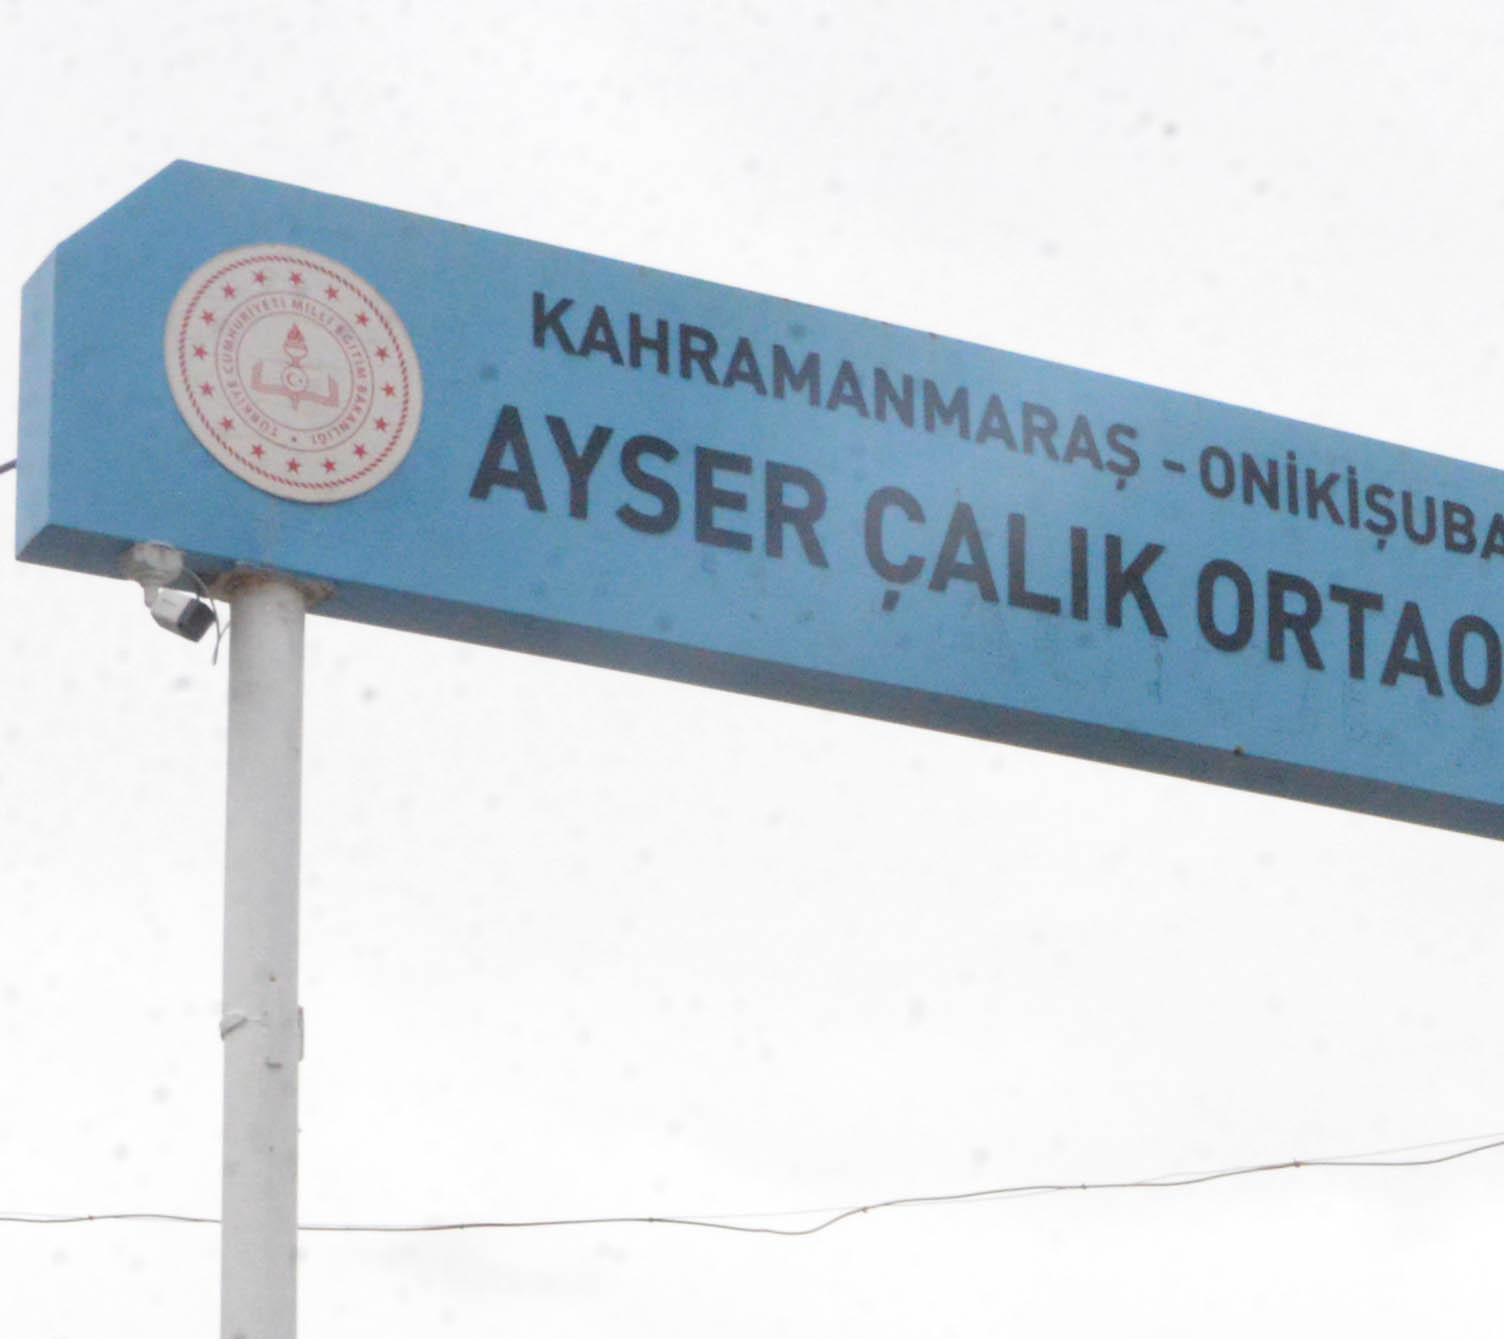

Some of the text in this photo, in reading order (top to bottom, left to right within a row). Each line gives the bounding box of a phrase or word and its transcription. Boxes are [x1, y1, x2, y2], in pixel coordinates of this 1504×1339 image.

[530, 290, 1141, 491] KAHRAMANMARAŞ
[468, 403, 830, 570] AYSER
[863, 484, 1169, 639] ÇALIK
